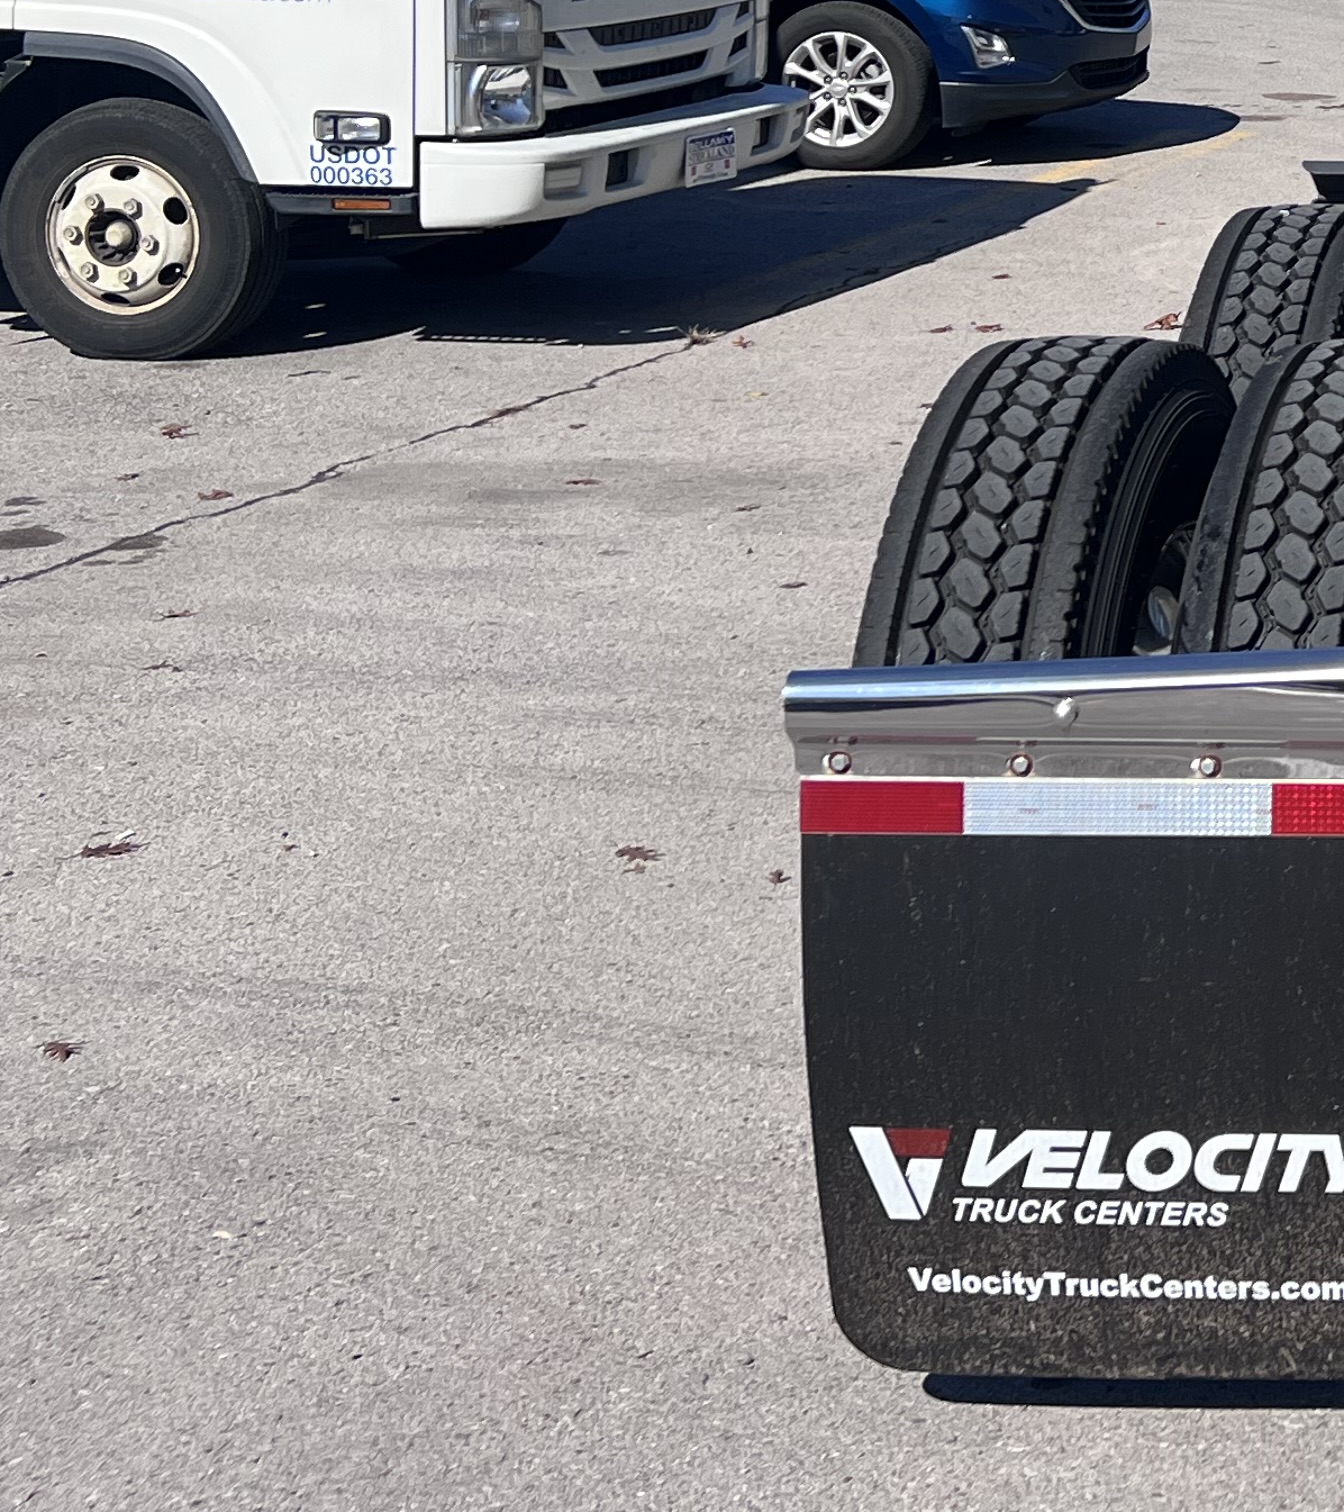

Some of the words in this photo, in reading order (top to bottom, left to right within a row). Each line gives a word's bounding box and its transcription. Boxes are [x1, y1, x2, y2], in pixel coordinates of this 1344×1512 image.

[310, 166, 393, 186] 000363
[952, 1198, 1066, 1225] TRUCK
[1073, 1200, 1229, 1228] CENTERS
